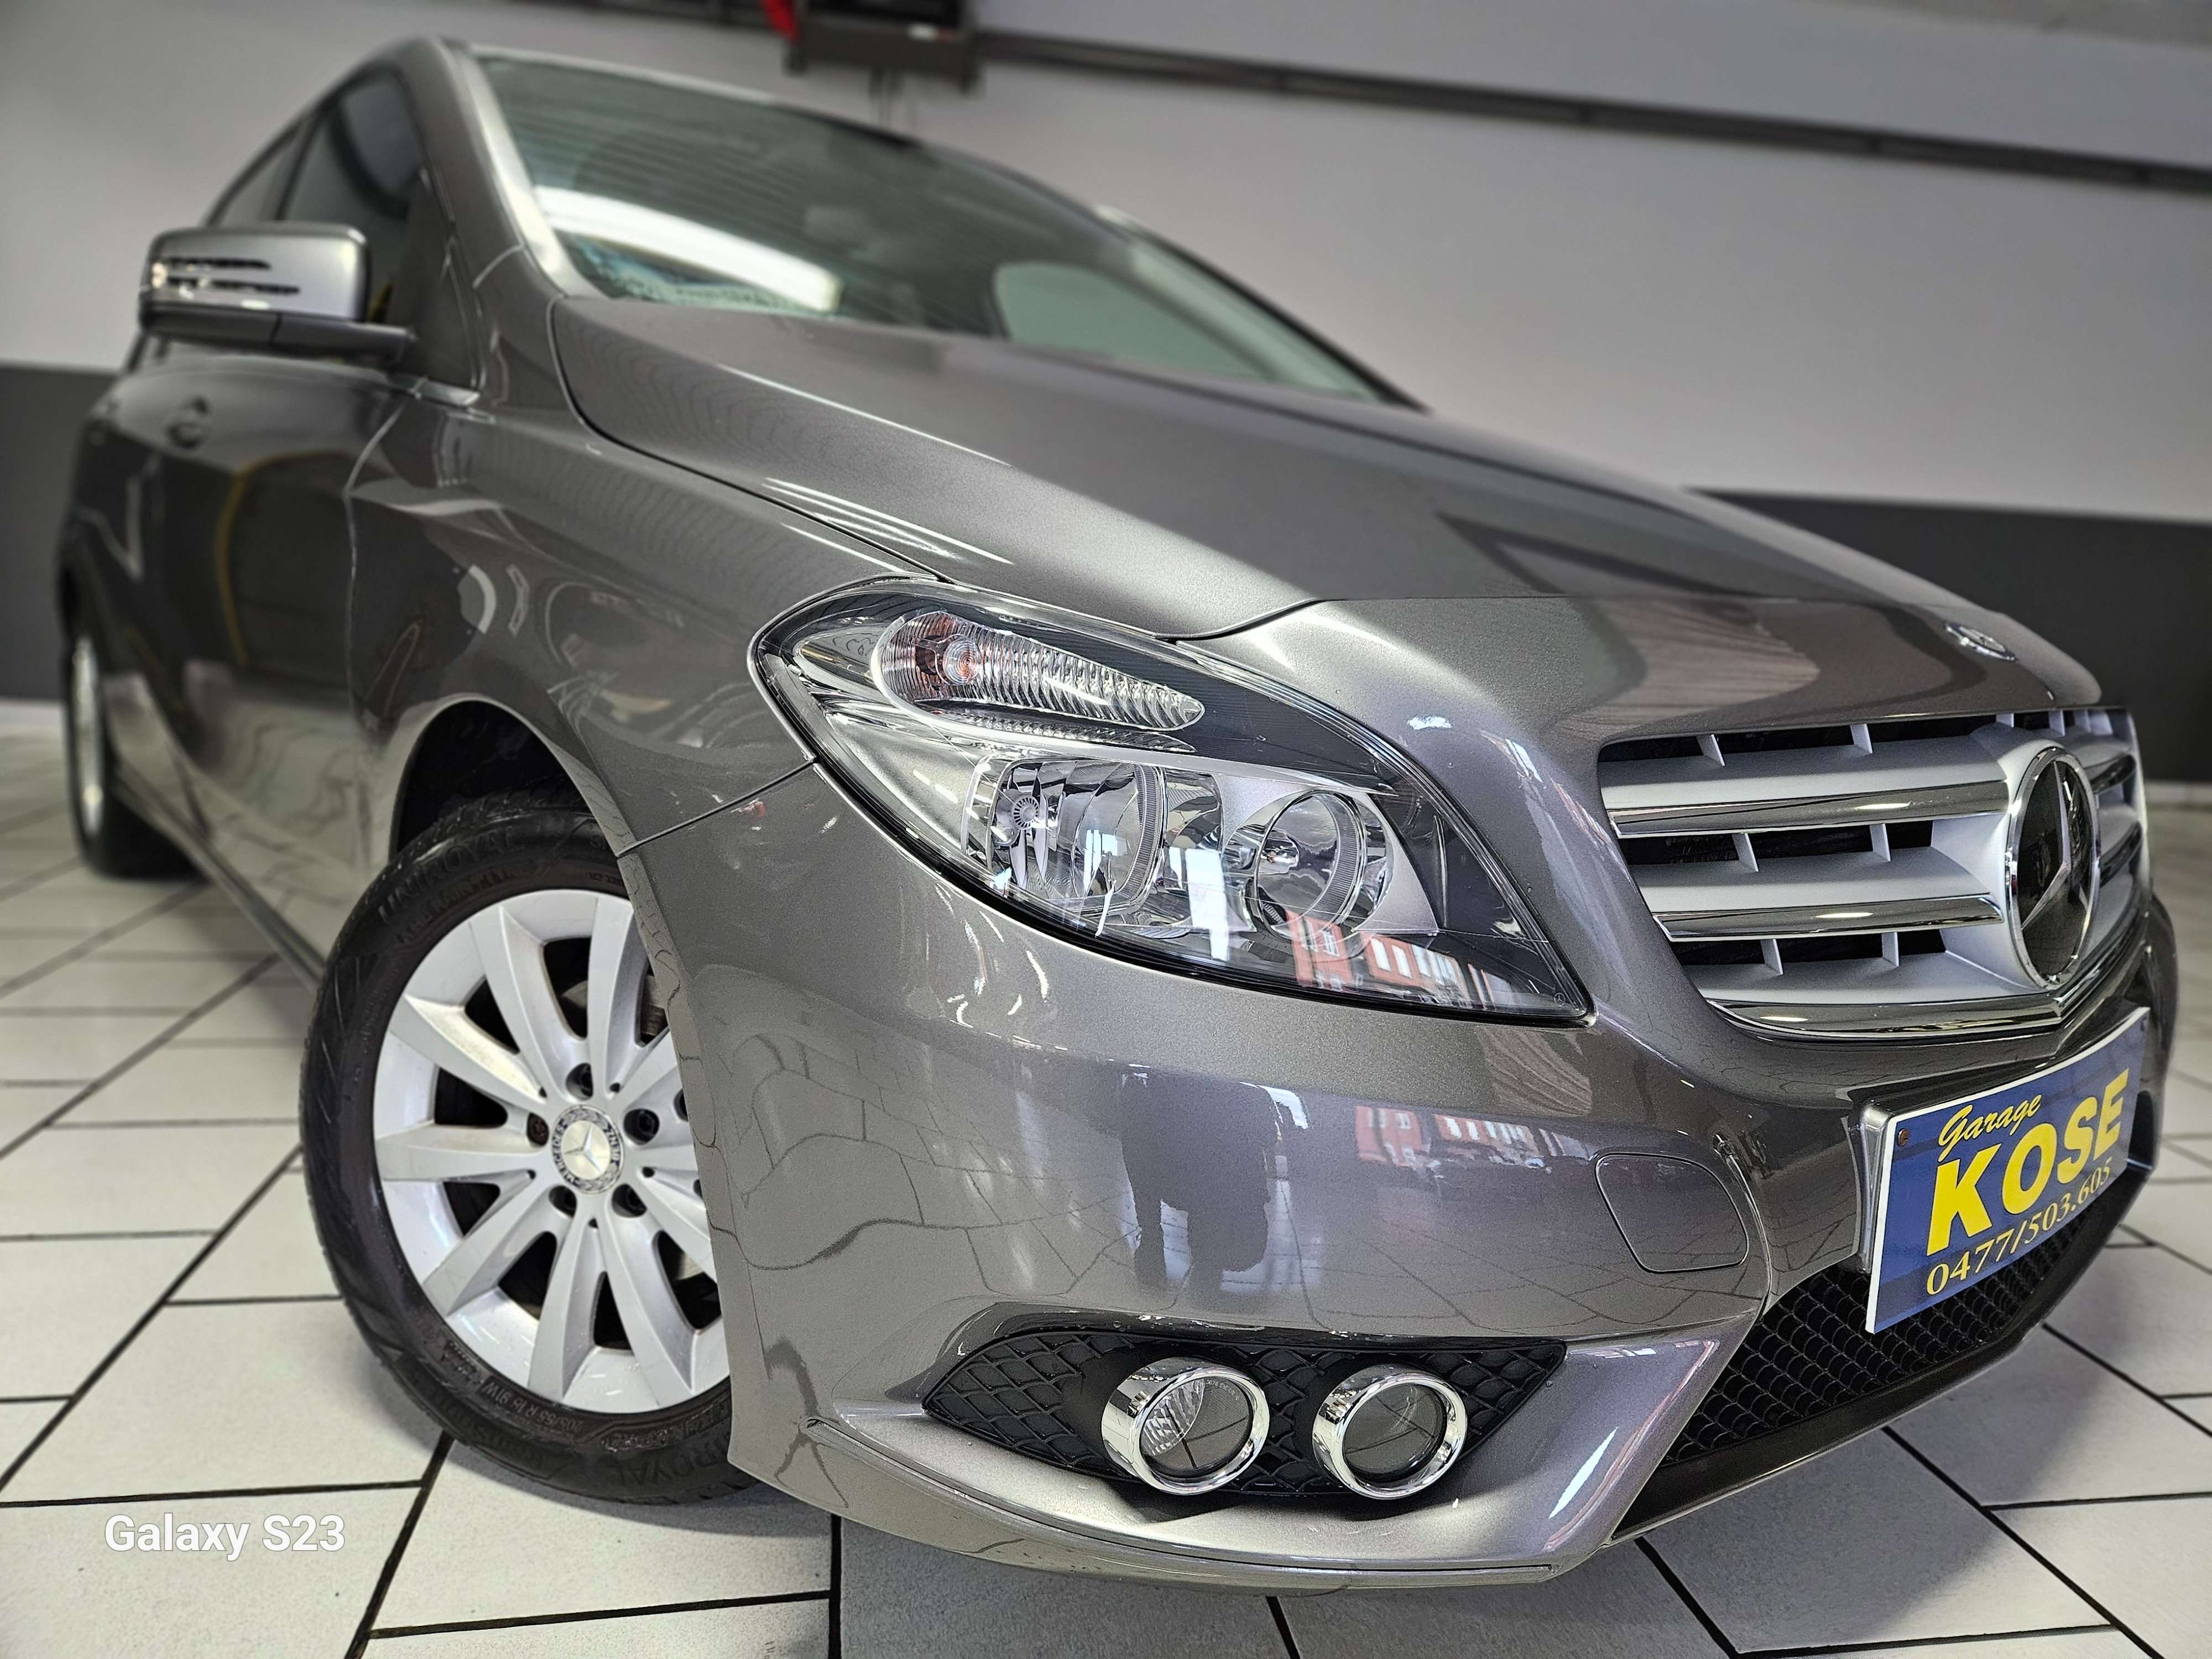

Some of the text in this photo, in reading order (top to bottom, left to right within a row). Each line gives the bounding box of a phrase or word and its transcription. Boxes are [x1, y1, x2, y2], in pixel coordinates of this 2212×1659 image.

[1938, 1094, 2042, 1162] Garage
[1927, 1068, 2129, 1256] KOSE
[1926, 1157, 2111, 1296] 0477/503.605
[483, 1382, 510, 1405] 91W
[526, 1405, 540, 1418] R
[540, 1410, 585, 1432] 205/55
